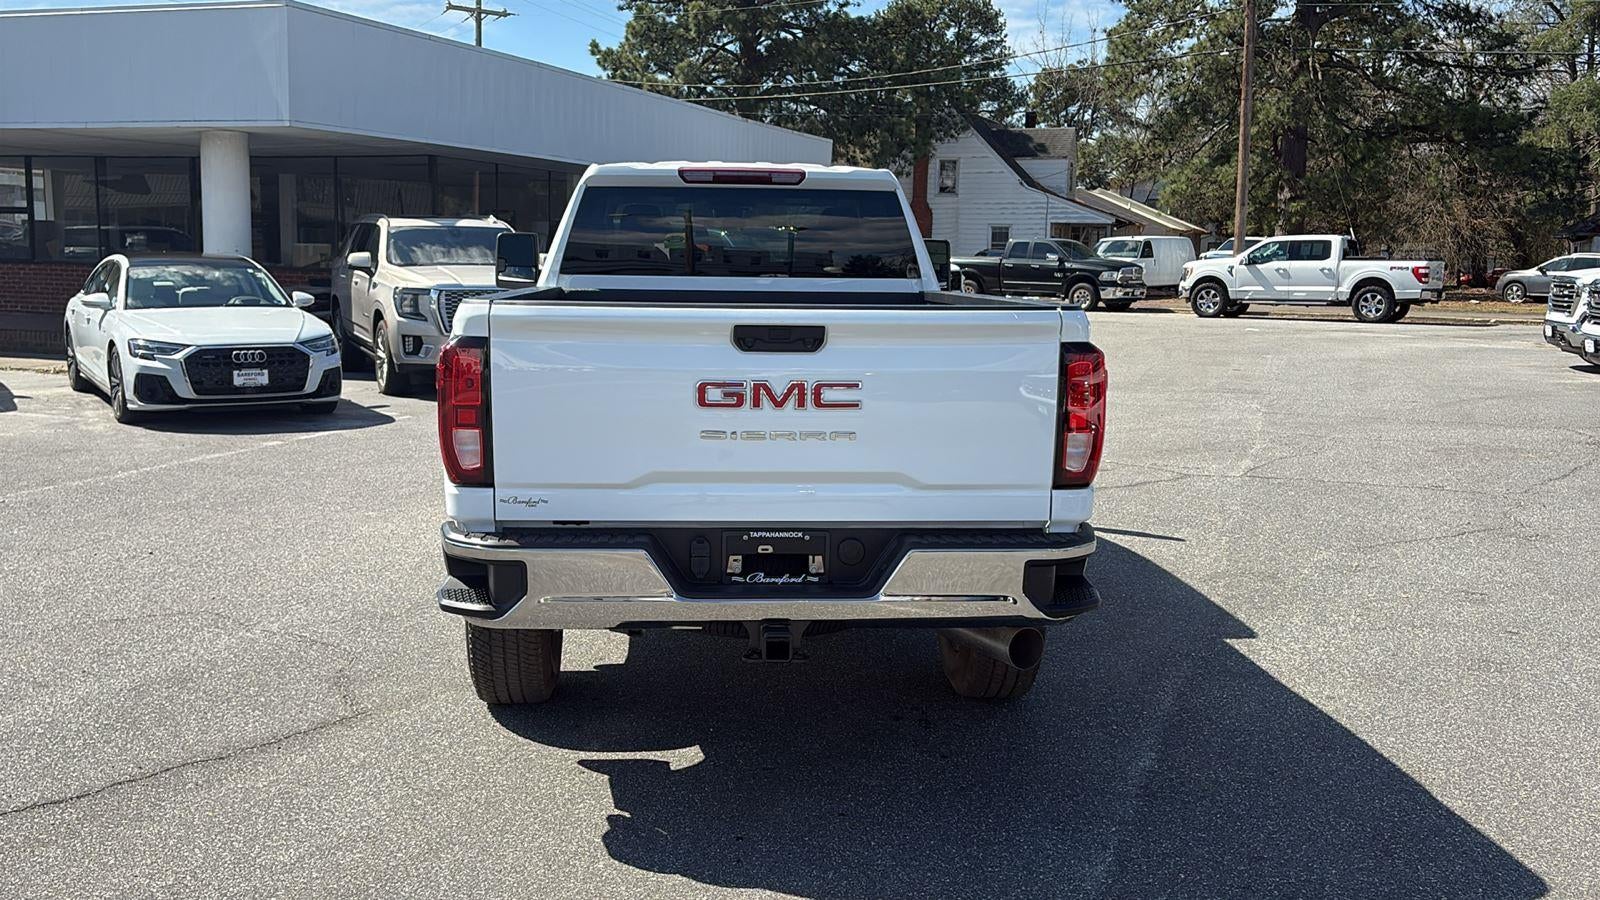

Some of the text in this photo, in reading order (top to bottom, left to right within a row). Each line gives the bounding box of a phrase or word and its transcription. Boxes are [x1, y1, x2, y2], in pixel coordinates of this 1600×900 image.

[696, 380, 862, 410] GMC
[700, 430, 856, 441] SIERRA
[746, 572, 806, 584] Bareford
